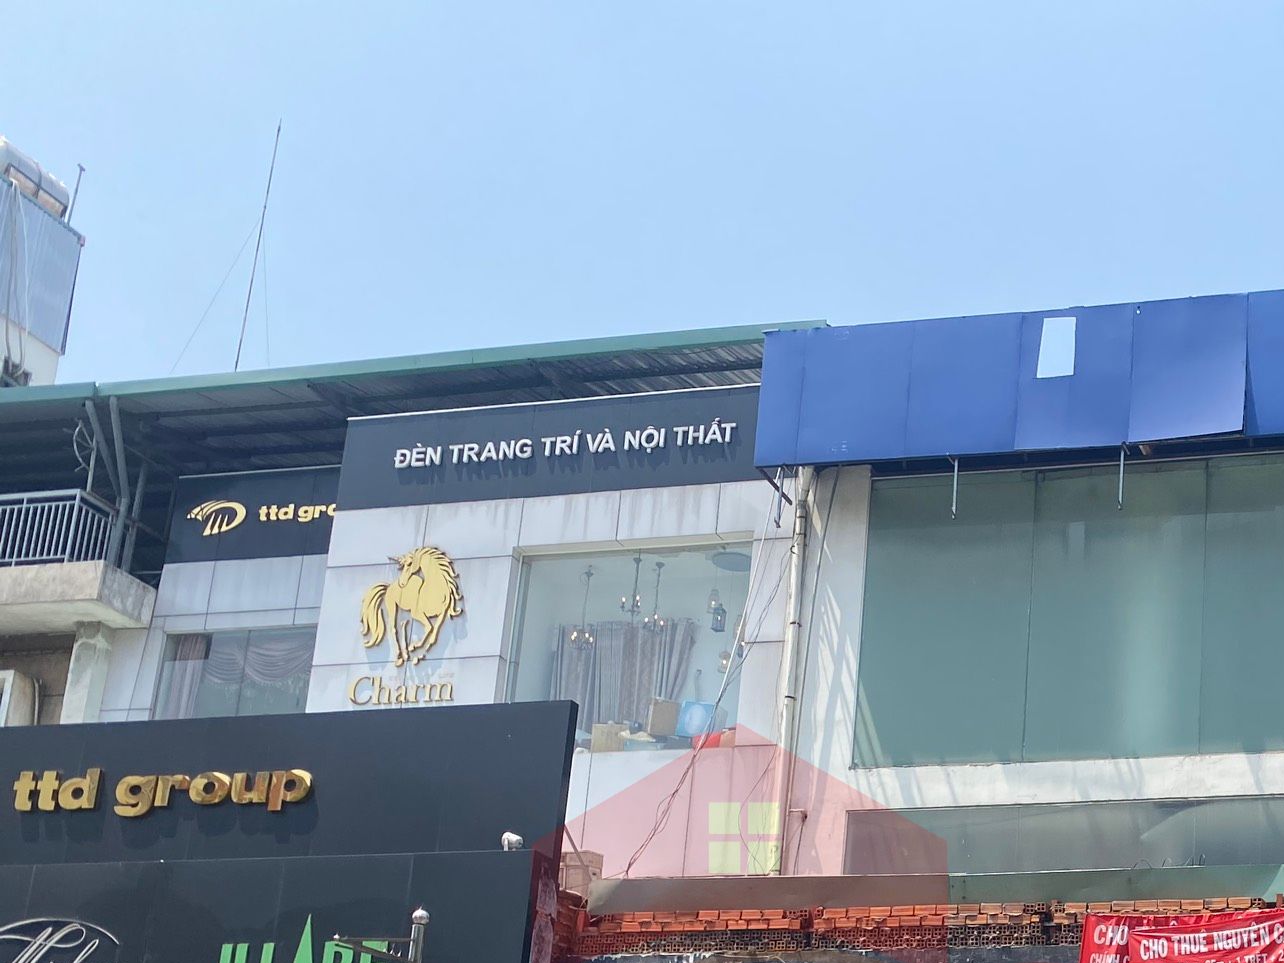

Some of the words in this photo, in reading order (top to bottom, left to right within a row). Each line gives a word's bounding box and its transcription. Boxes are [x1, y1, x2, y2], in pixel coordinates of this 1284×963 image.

[394, 443, 442, 469] ĐÈN
[449, 438, 533, 464] TRANG
[541, 429, 582, 457] TRÍ
[586, 428, 616, 454] VÀ
[623, 425, 666, 454] NỘI
[672, 417, 737, 447] THẤT
[259, 504, 295, 522] ttd
[347, 676, 455, 706] Charm
[13, 768, 101, 811] ttd
[113, 768, 313, 817] group
[1094, 924, 1129, 946] CHO
[1140, 937, 1169, 960] CHO
[1171, 929, 1209, 956] THUÊ
[1213, 922, 1270, 951] NGUYÊN
[1279, 949, 1284, 962] 2
